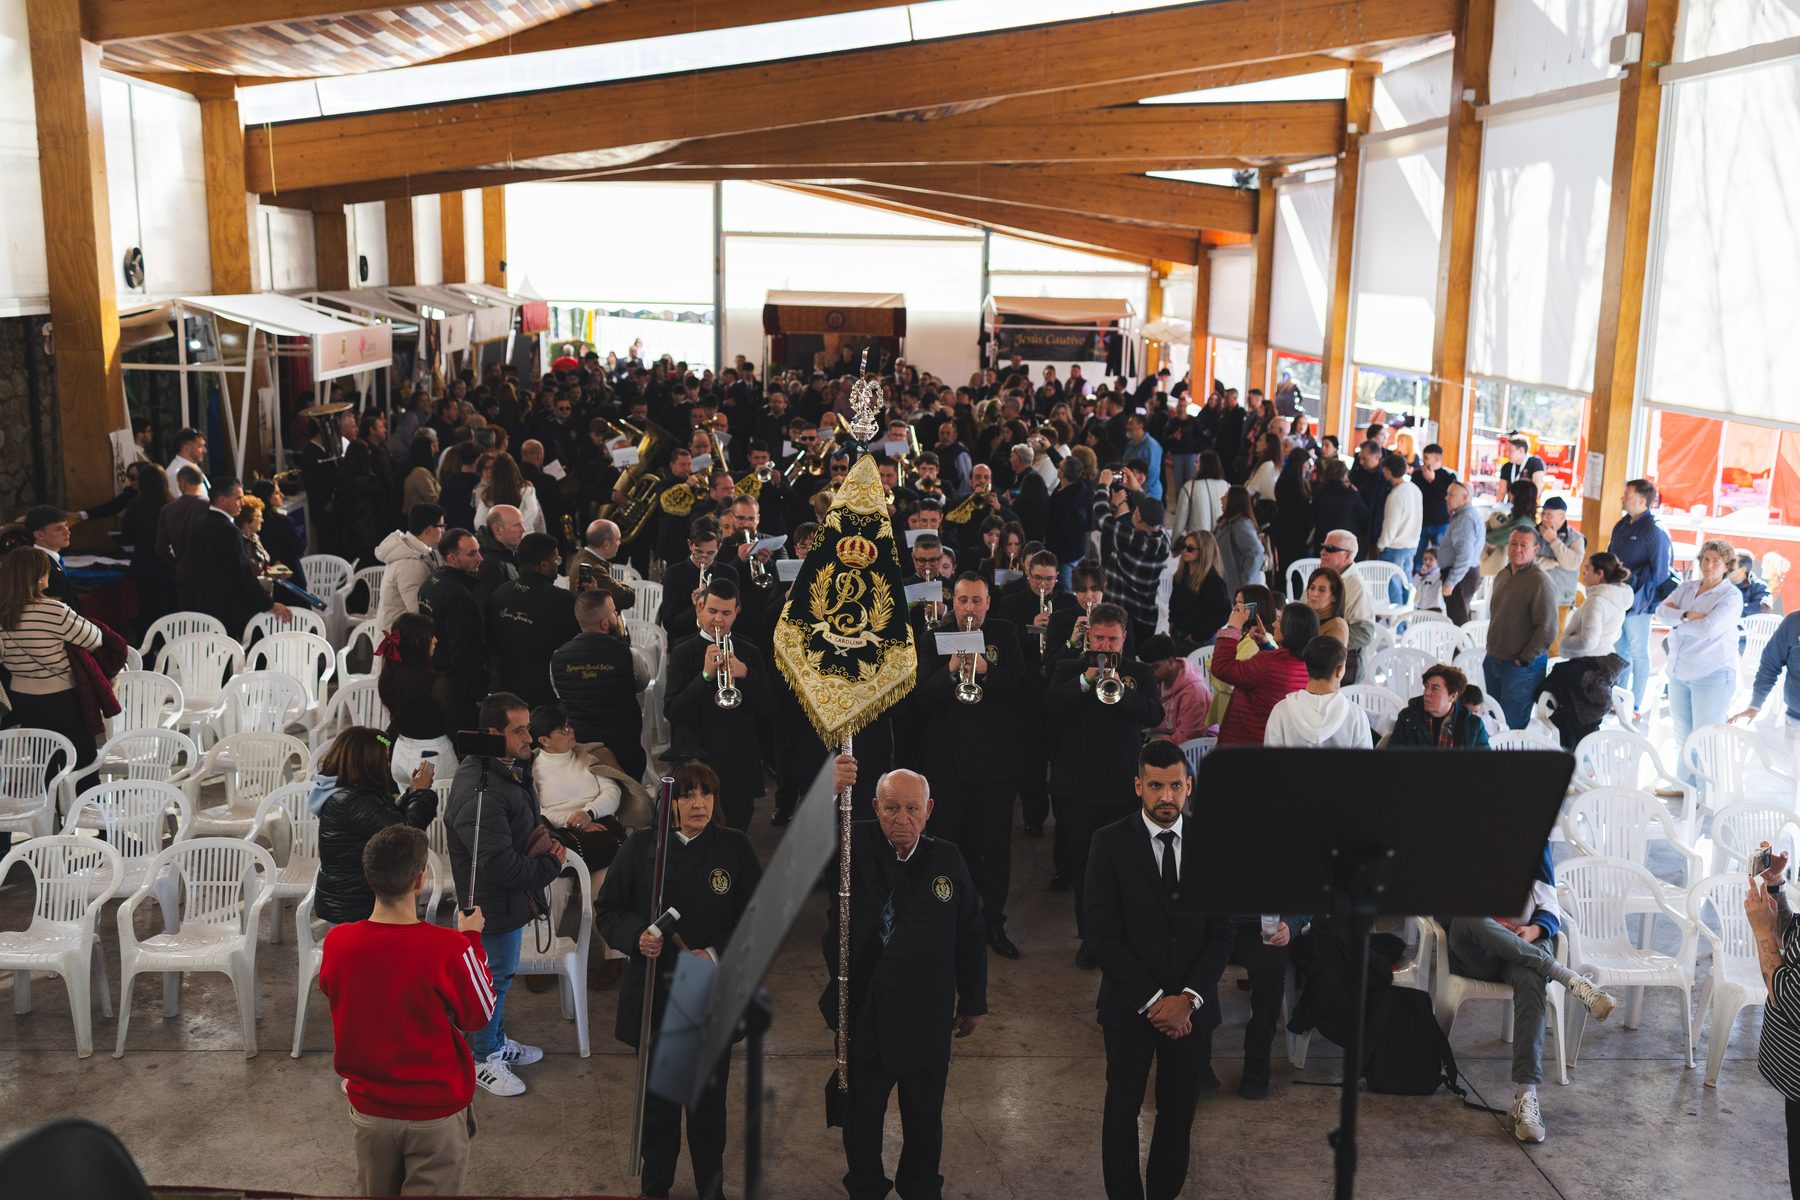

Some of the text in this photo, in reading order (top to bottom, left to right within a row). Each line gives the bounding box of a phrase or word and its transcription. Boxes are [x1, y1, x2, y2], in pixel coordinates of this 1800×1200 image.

[1045, 333, 1087, 347] Cautivo
[825, 633, 864, 646] LA CAROLINA
